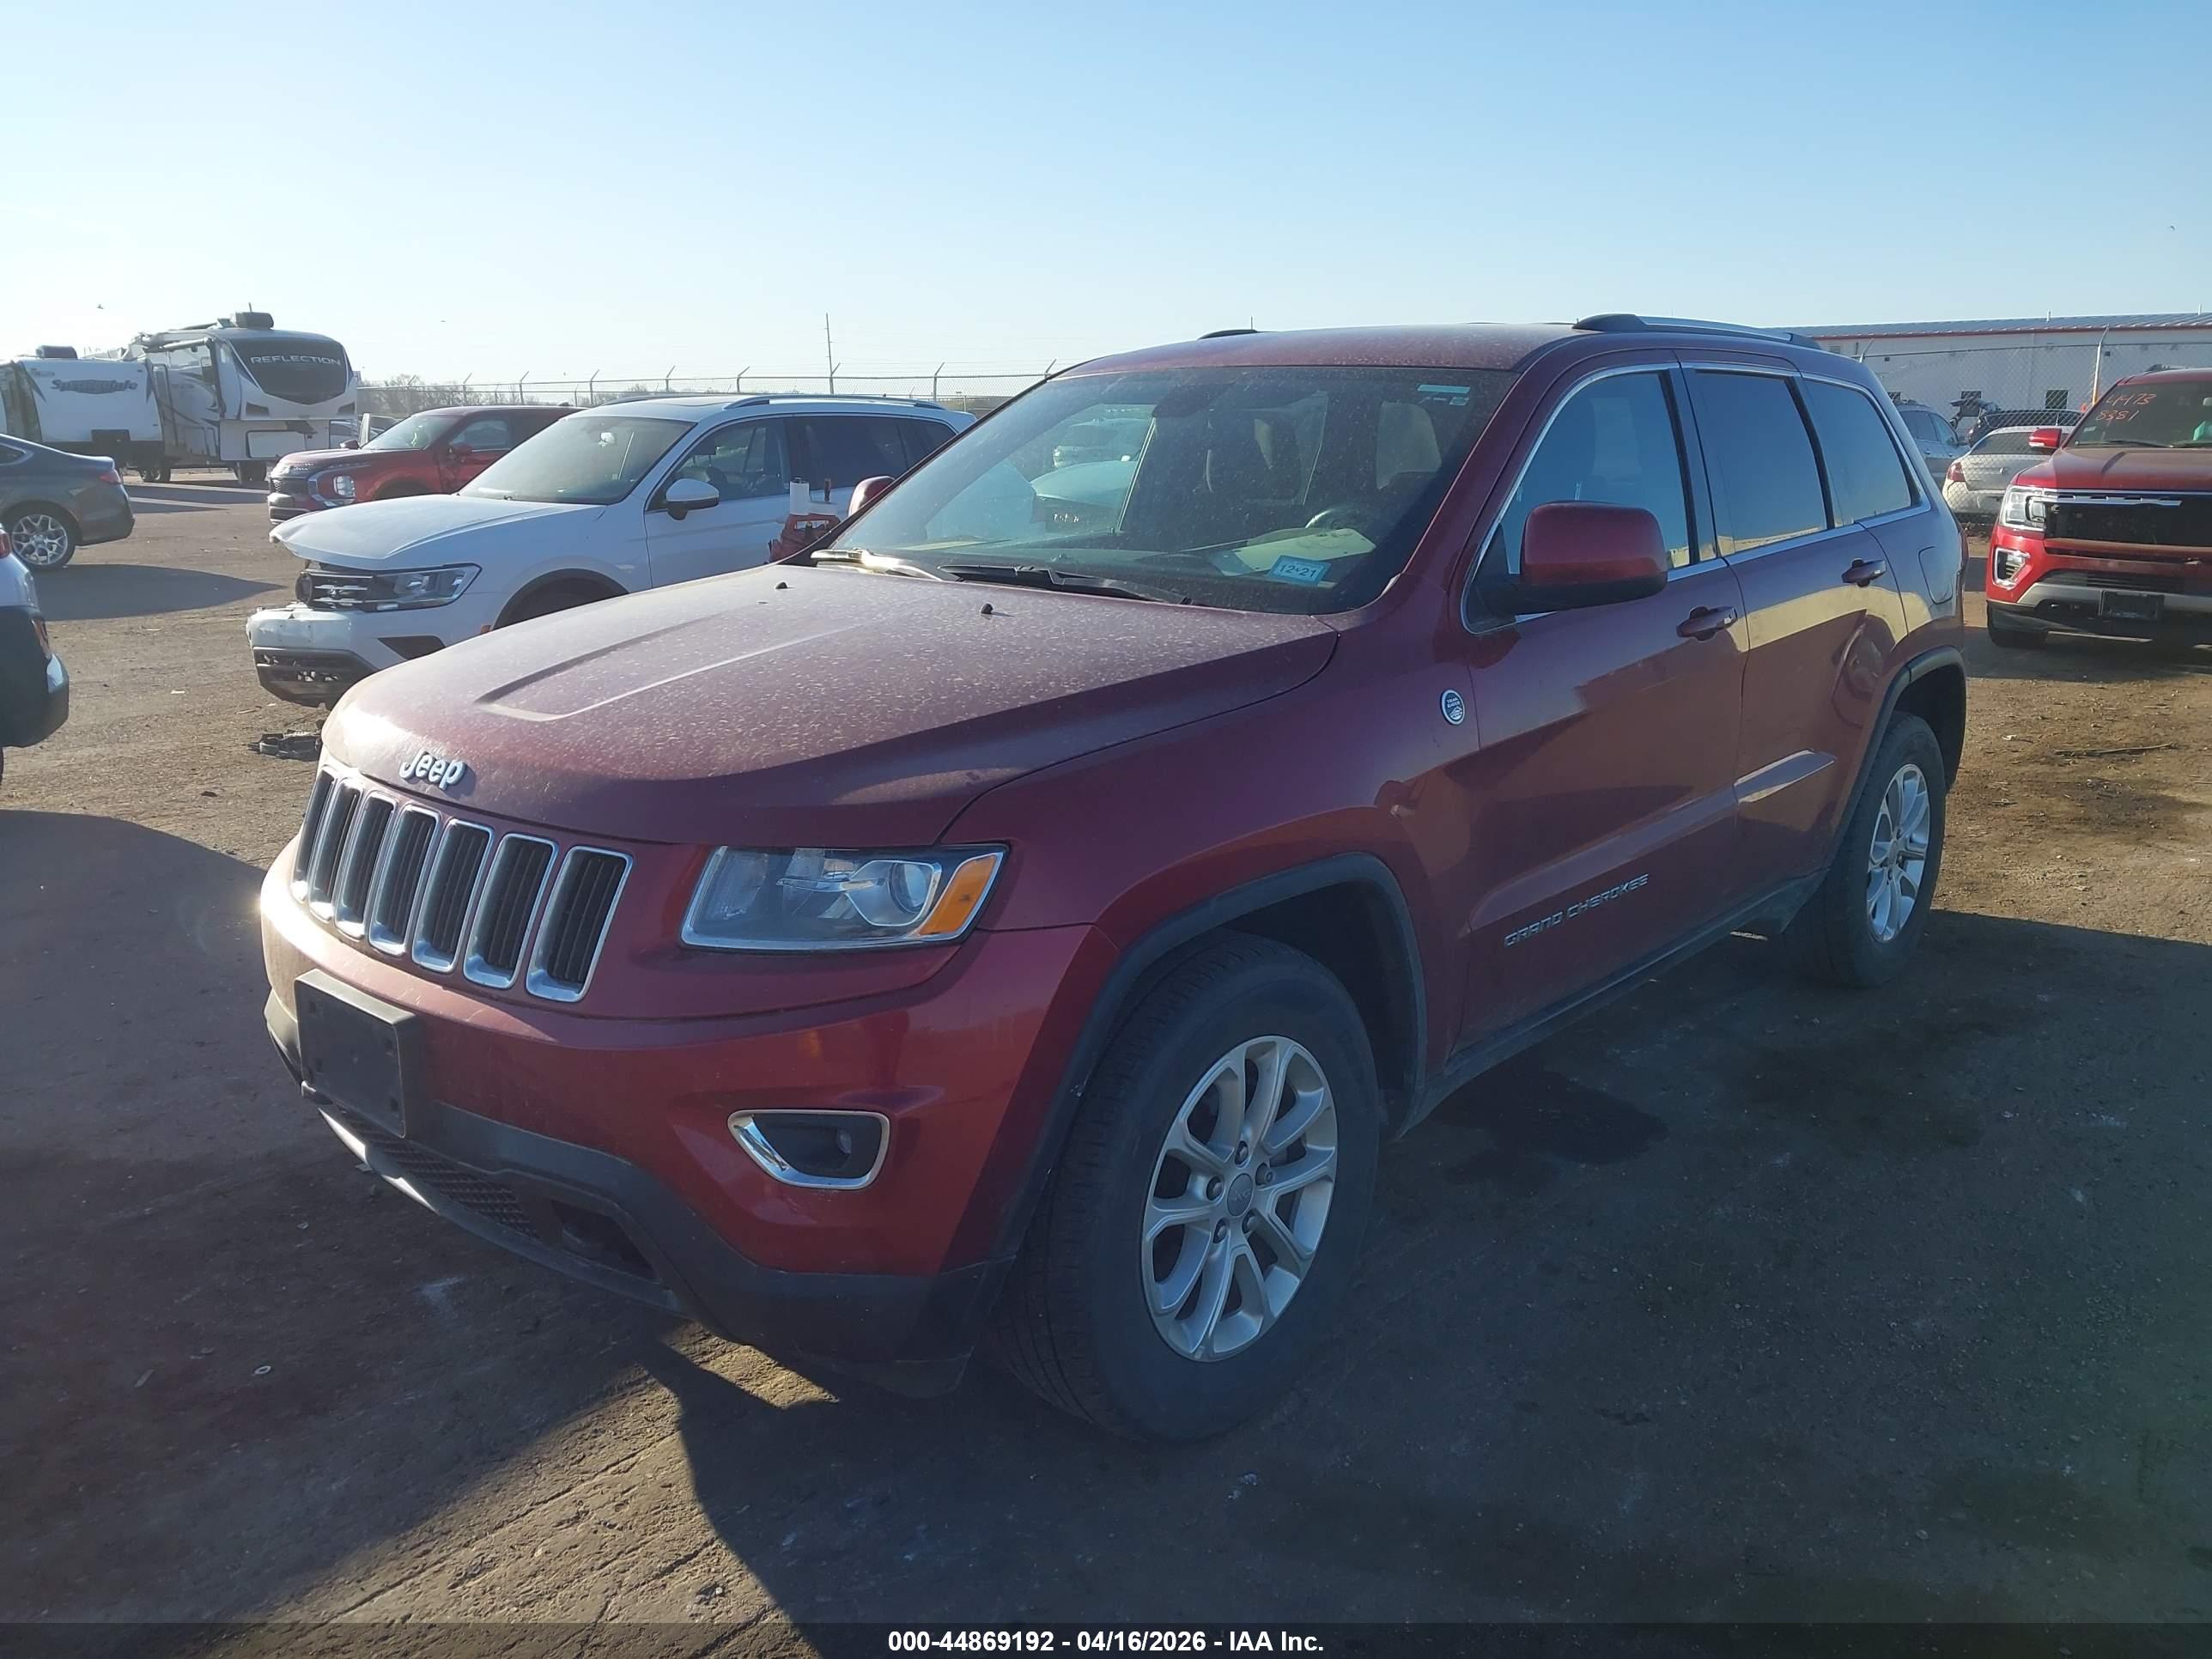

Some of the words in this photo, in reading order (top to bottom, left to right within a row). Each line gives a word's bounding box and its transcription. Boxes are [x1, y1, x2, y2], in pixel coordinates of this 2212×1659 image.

[250, 355, 341, 366] REFLECTION
[398, 748, 465, 790] Jeep
[1504, 911, 1564, 945] GRAND
[1565, 873, 1650, 918] CHEROKEE
